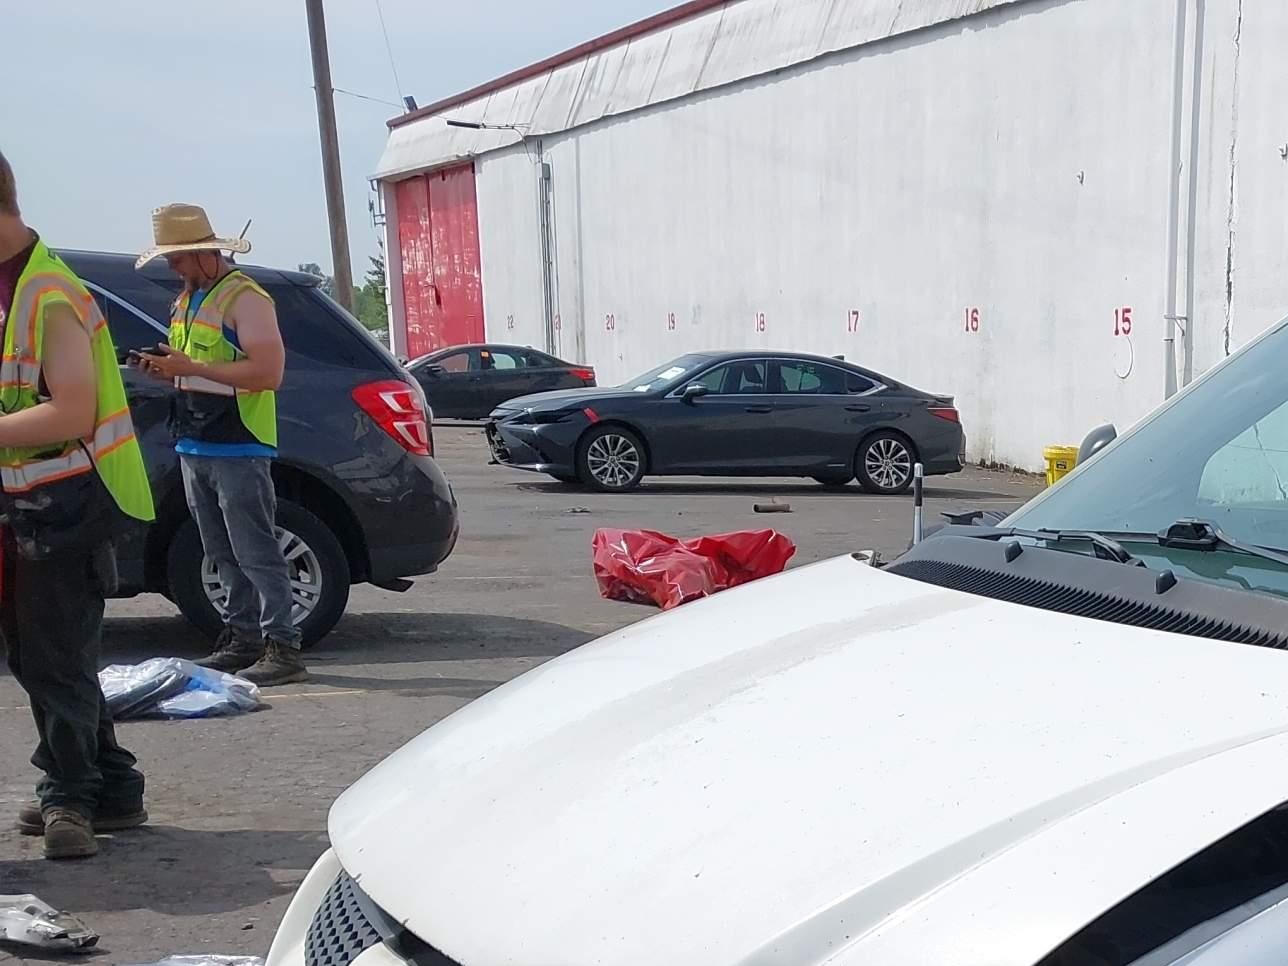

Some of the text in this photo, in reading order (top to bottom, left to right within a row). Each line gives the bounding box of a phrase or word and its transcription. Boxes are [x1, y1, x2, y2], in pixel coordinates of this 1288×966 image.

[605, 314, 615, 330] 20
[667, 312, 676, 330] 19
[755, 313, 766, 332] 18
[847, 309, 860, 332] 17
[965, 307, 980, 332] 16
[1114, 307, 1132, 336] 15
